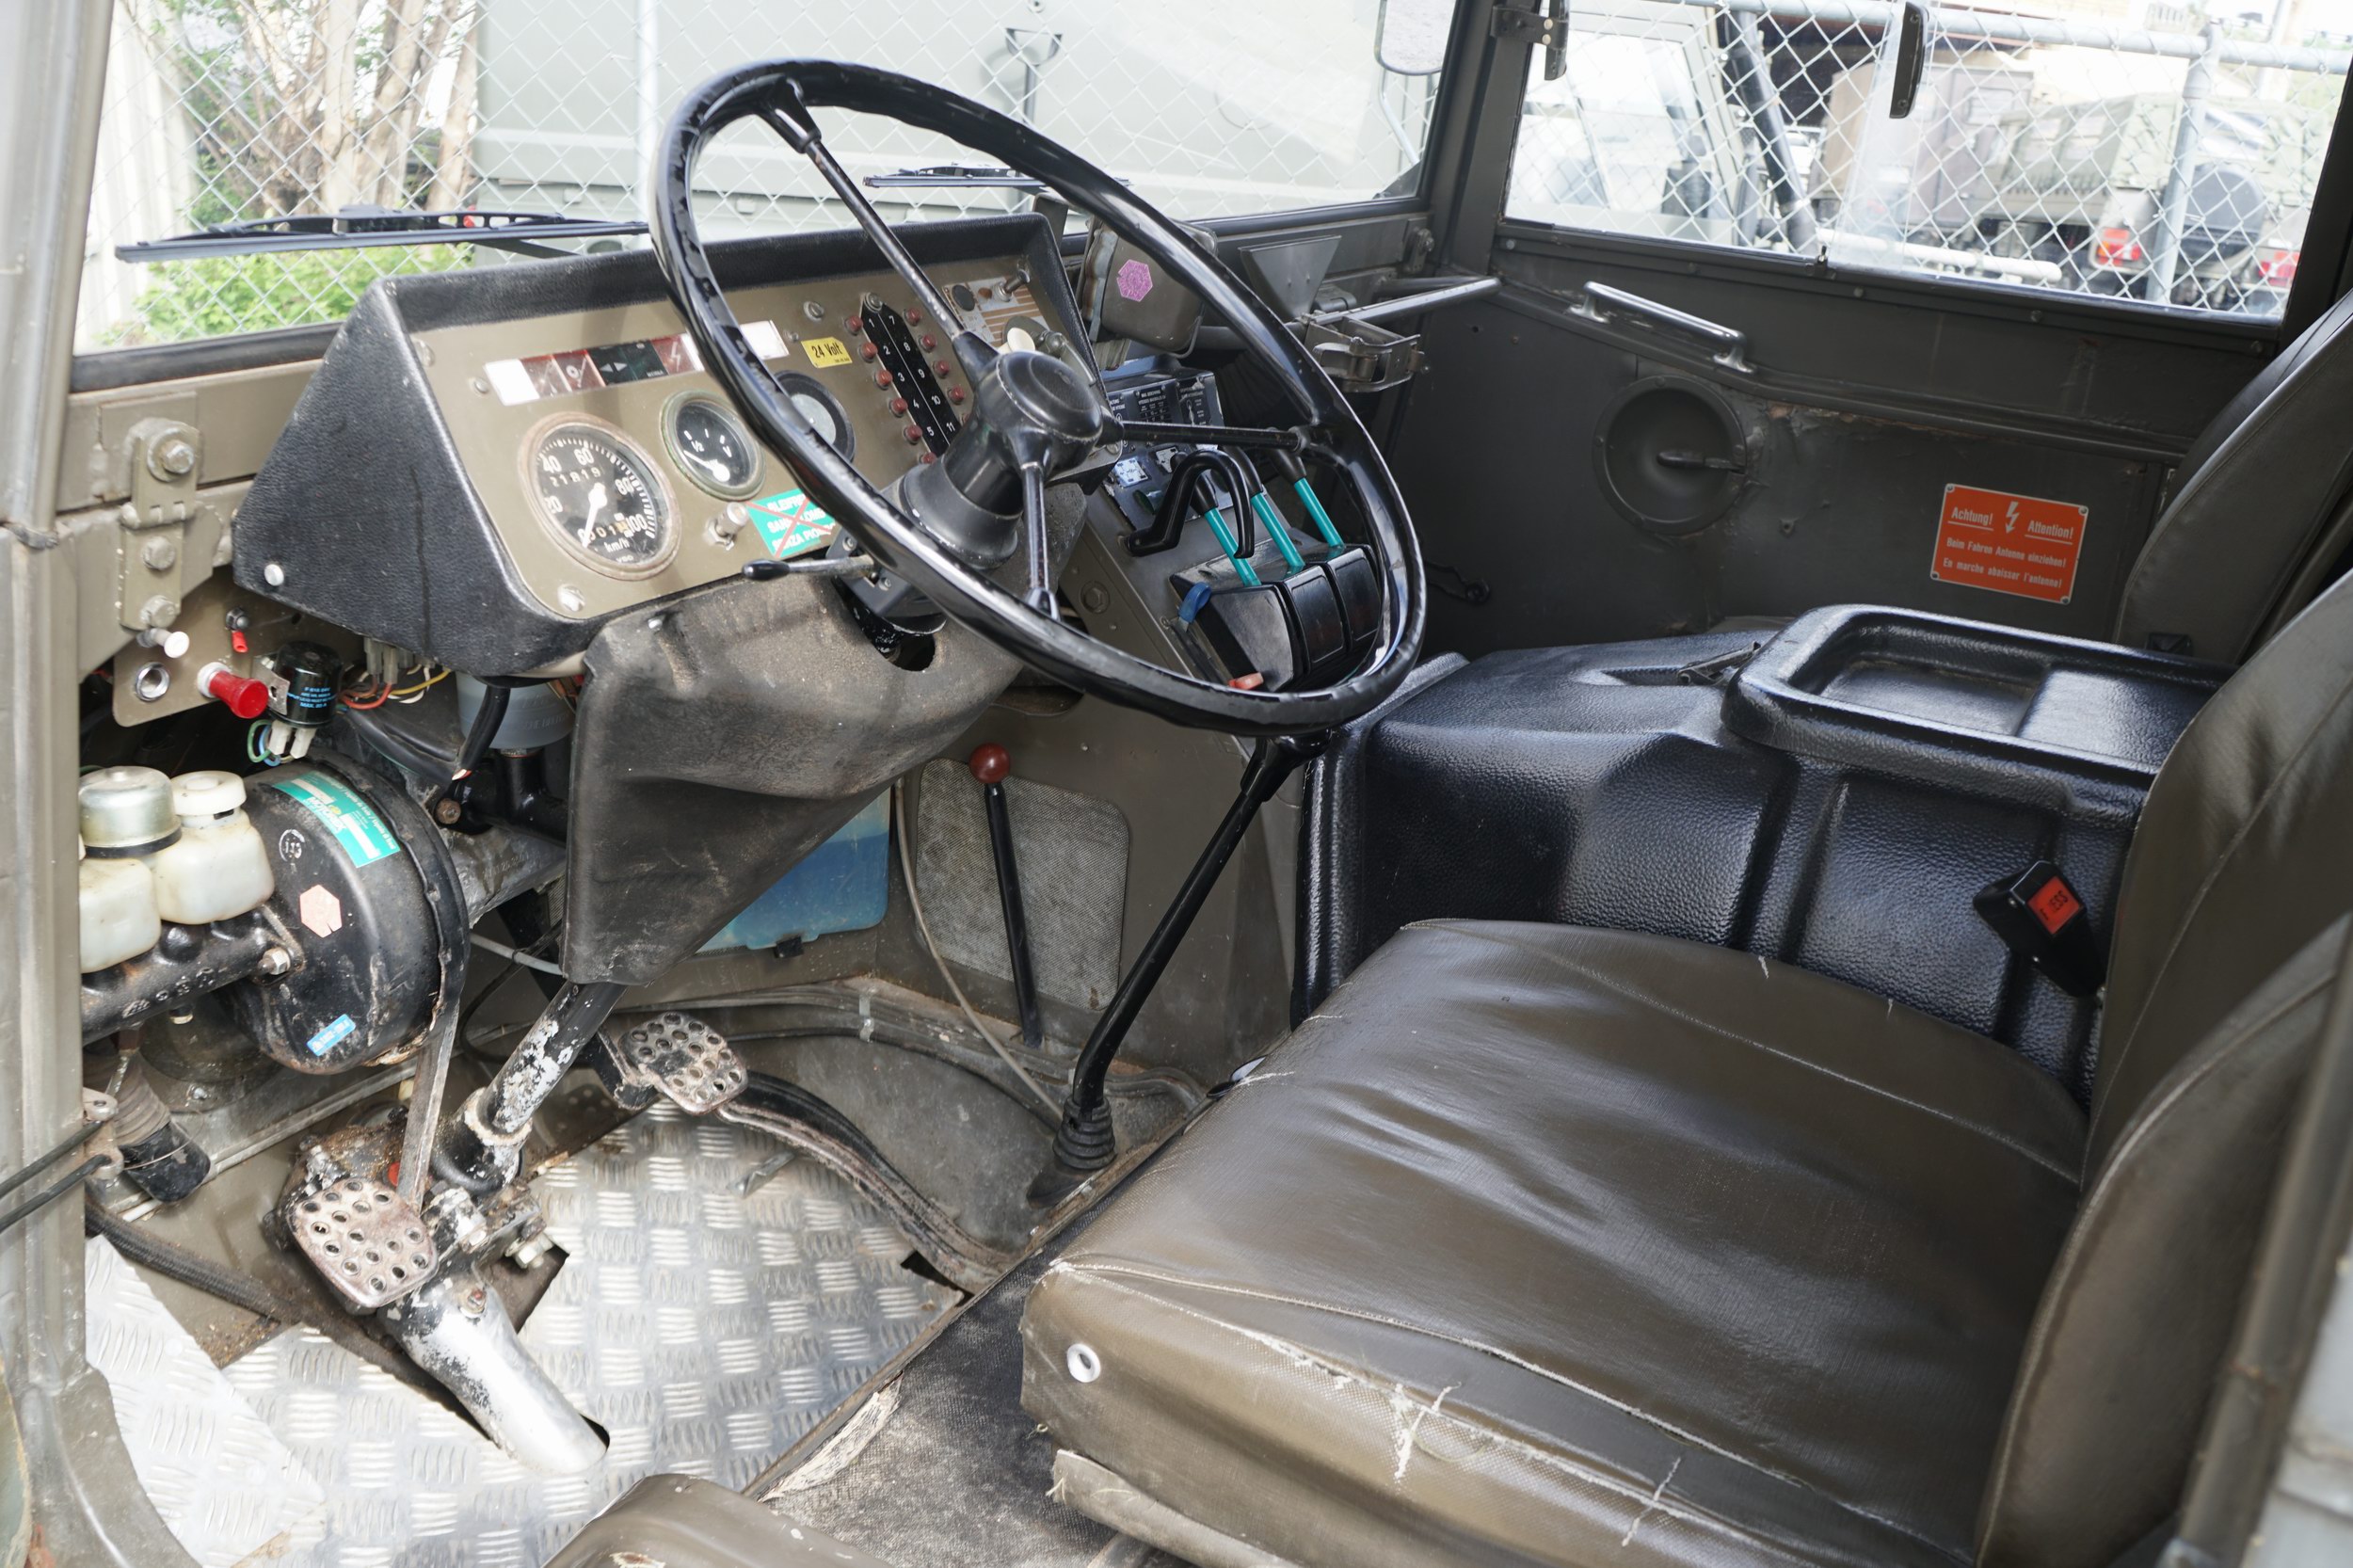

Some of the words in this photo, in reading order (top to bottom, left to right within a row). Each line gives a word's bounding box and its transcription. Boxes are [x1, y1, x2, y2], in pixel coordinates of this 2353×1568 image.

[869, 318, 875, 328] 1
[888, 315, 895, 325] 7
[811, 344, 824, 359] 24
[824, 342, 842, 356] Volt
[883, 345, 890, 355] 2
[904, 342, 911, 352] 8
[898, 372, 905, 382] 3
[918, 369, 925, 378] 9
[913, 399, 920, 408] 4
[932, 395, 941, 406] 10
[927, 426, 935, 437] 5
[947, 422, 956, 432] 11
[573, 447, 594, 465] 60
[542, 455, 562, 473] 40
[615, 477, 634, 495] 80
[544, 496, 563, 514] 20
[626, 514, 648, 534] 100
[1951, 506, 1993, 525] Achtung!
[2027, 520, 2073, 539] Attention!
[603, 538, 630, 553] km/h
[1946, 536, 1965, 550] Beim
[1967, 540, 1993, 554] Fahren
[1995, 546, 2025, 561] Antenne
[2027, 552, 2067, 568] einziehen!
[1943, 557, 1953, 568] En
[1957, 561, 1984, 574] marche
[1988, 565, 2021, 581] abaisser
[2024, 572, 2063, 588] l'antenne!
